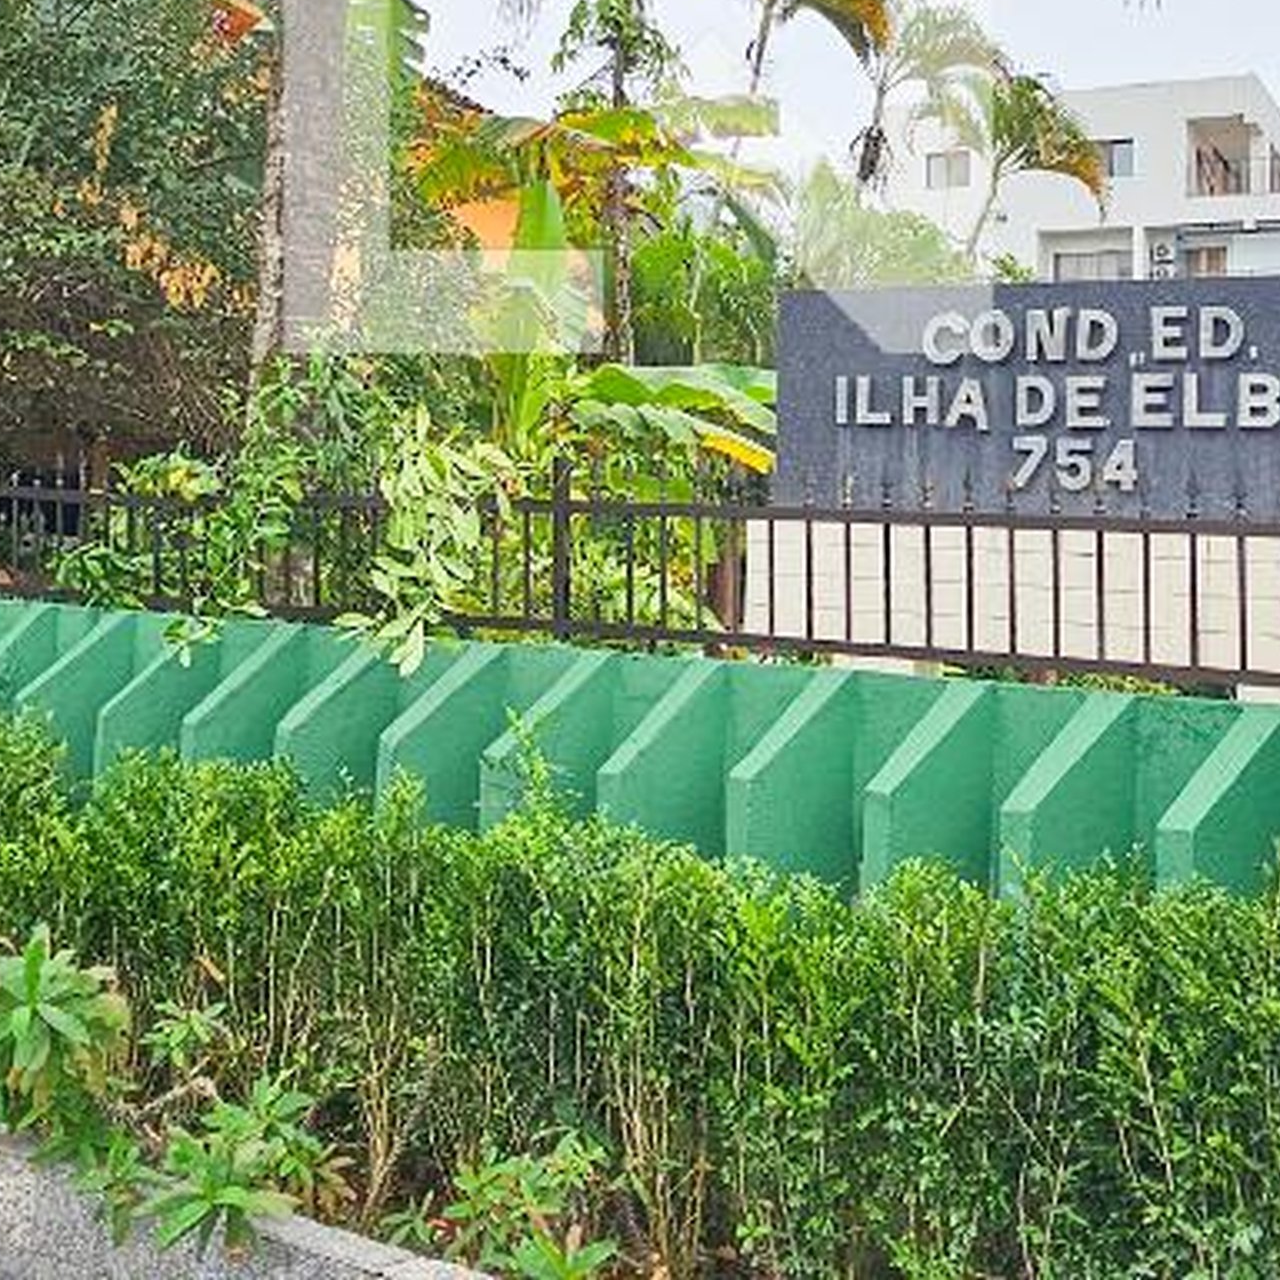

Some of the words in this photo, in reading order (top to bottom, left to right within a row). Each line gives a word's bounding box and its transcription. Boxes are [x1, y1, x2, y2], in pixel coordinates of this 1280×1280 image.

[1151, 305, 1257, 360] ED.
[835, 374, 989, 431] ILHA
[1016, 374, 1111, 428] DE
[1013, 434, 1139, 491] 754
